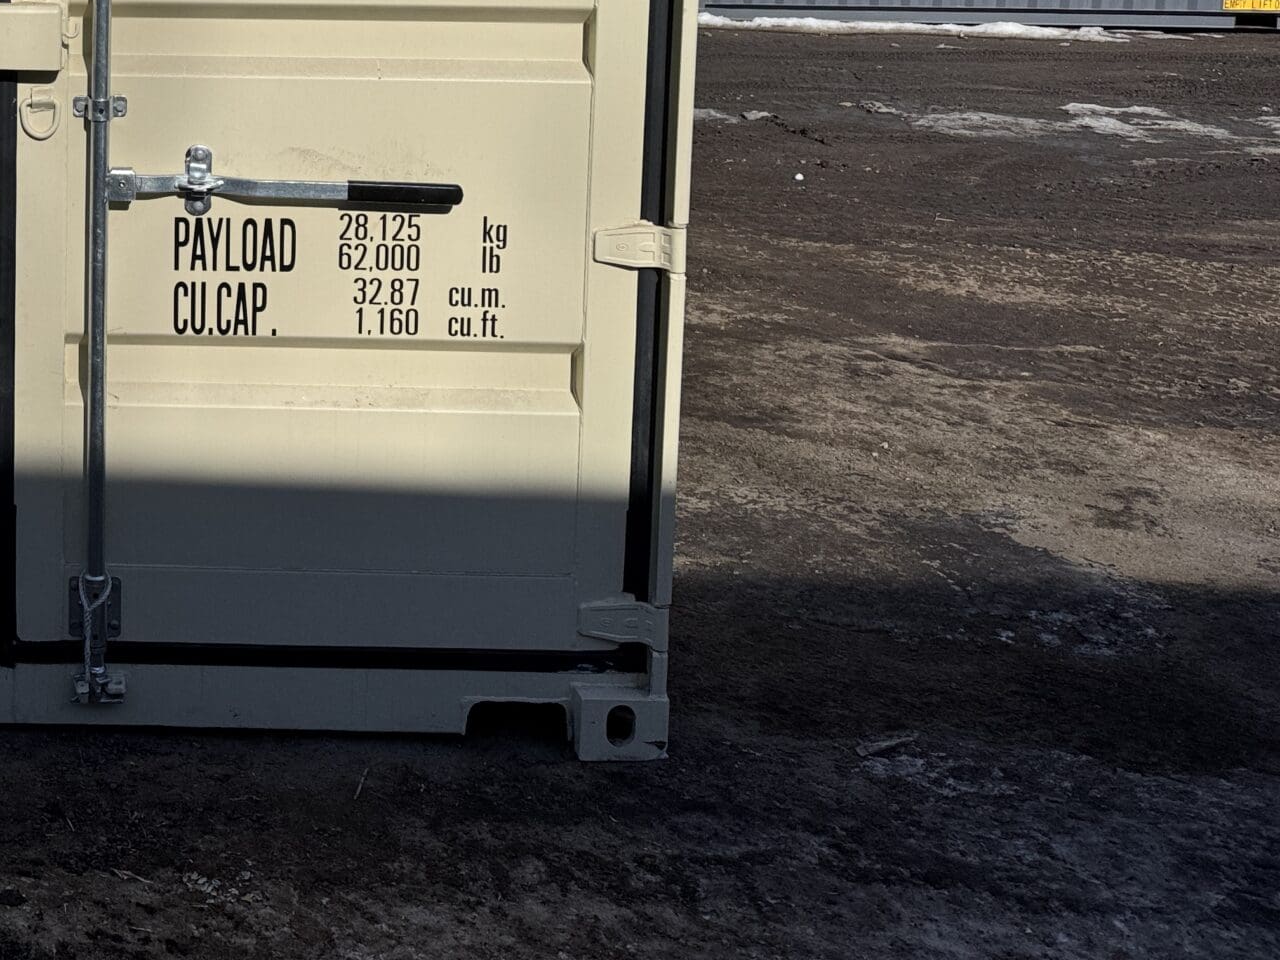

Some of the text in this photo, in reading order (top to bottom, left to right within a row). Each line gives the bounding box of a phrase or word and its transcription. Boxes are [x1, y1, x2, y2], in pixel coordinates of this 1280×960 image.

[174, 213, 508, 272] PAYLOAD 28,125 kg
[338, 243, 501, 273] 62,000 lb
[353, 278, 420, 306] 32.87
[448, 285, 506, 309] cu.m.
[355, 308, 505, 339] 1,160 cu.ft.
